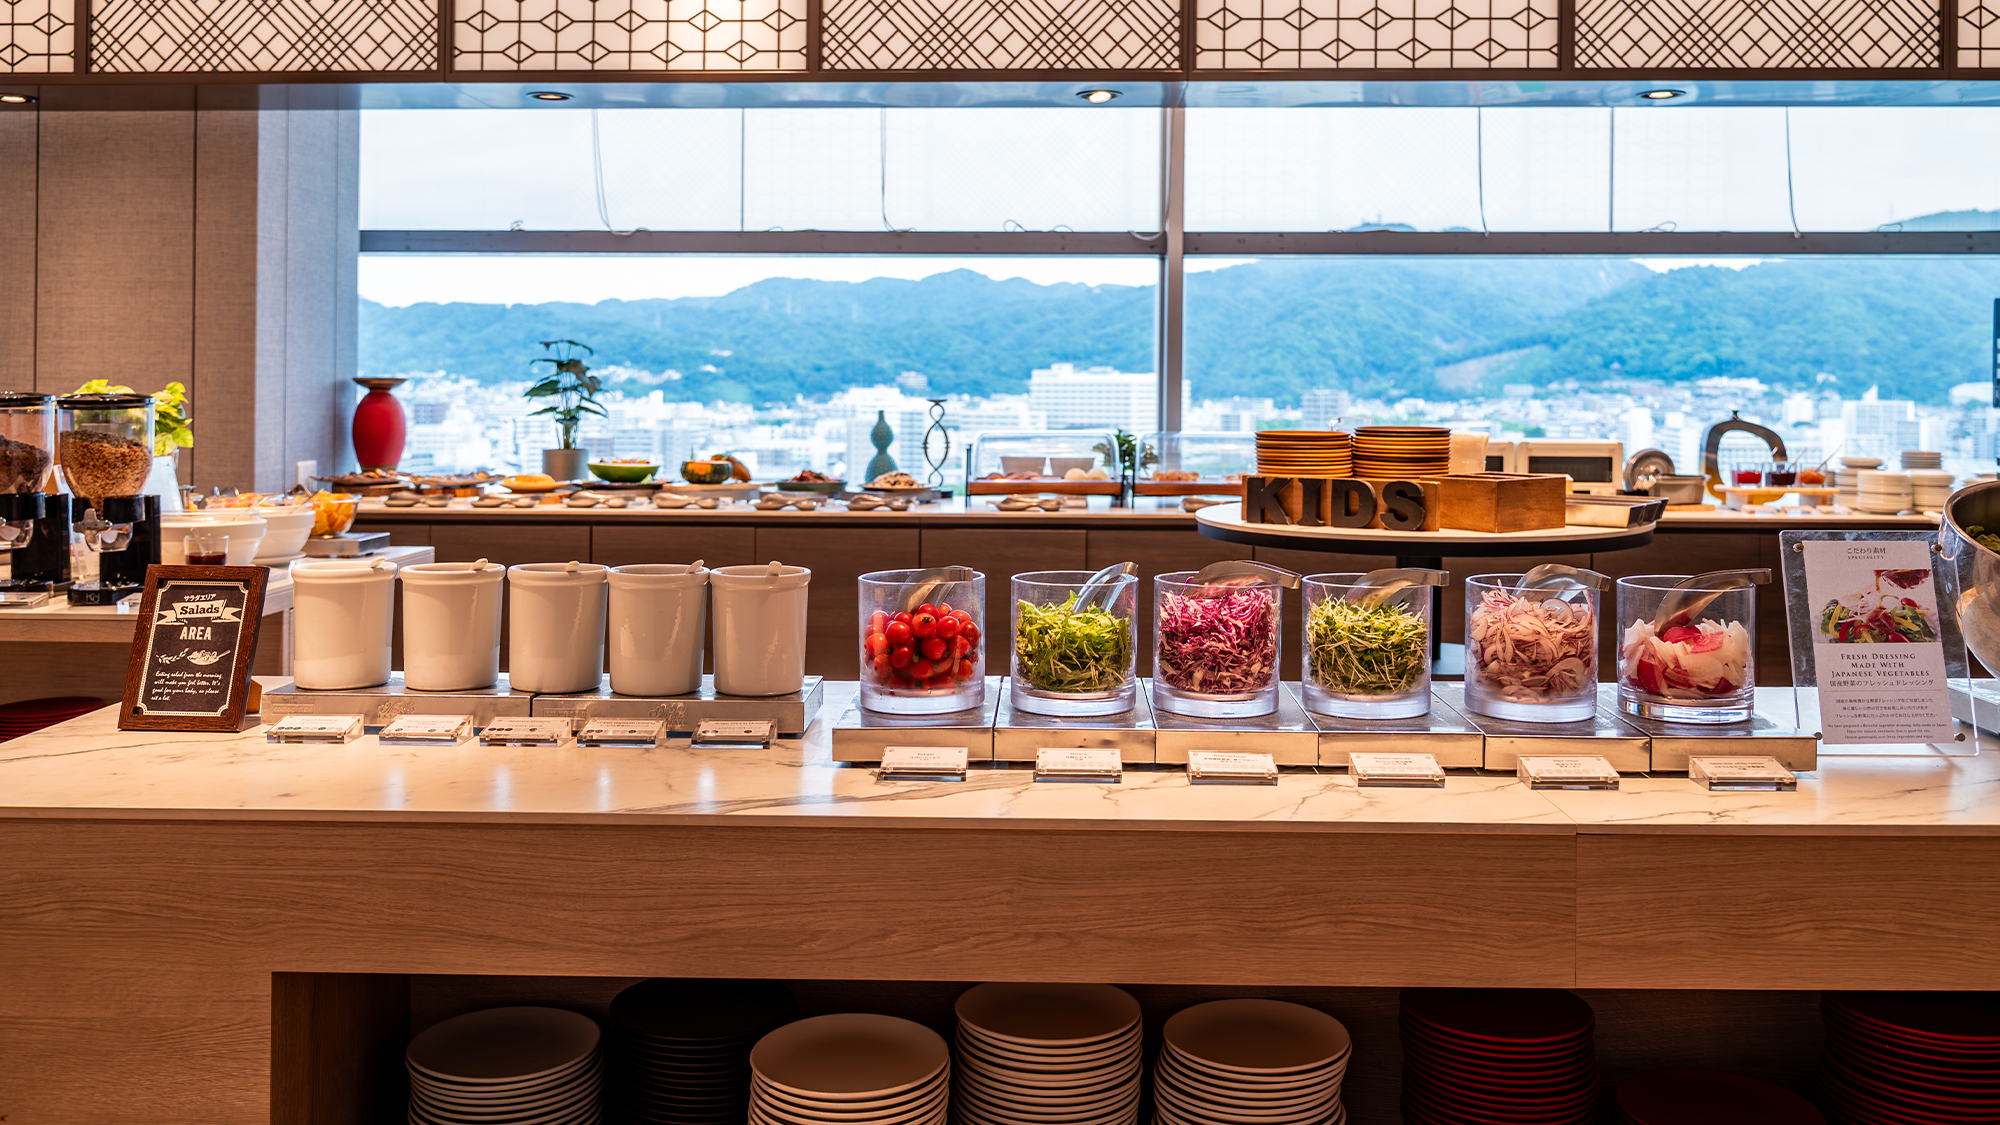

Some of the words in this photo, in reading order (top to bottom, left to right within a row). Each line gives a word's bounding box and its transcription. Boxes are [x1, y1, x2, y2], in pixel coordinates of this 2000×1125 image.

[1247, 477, 1425, 531] KIDS
[184, 594, 216, 602] サラダエリア
[180, 604, 220, 615] Salads
[180, 626, 212, 640] AREA
[156, 670, 170, 678] Eating
